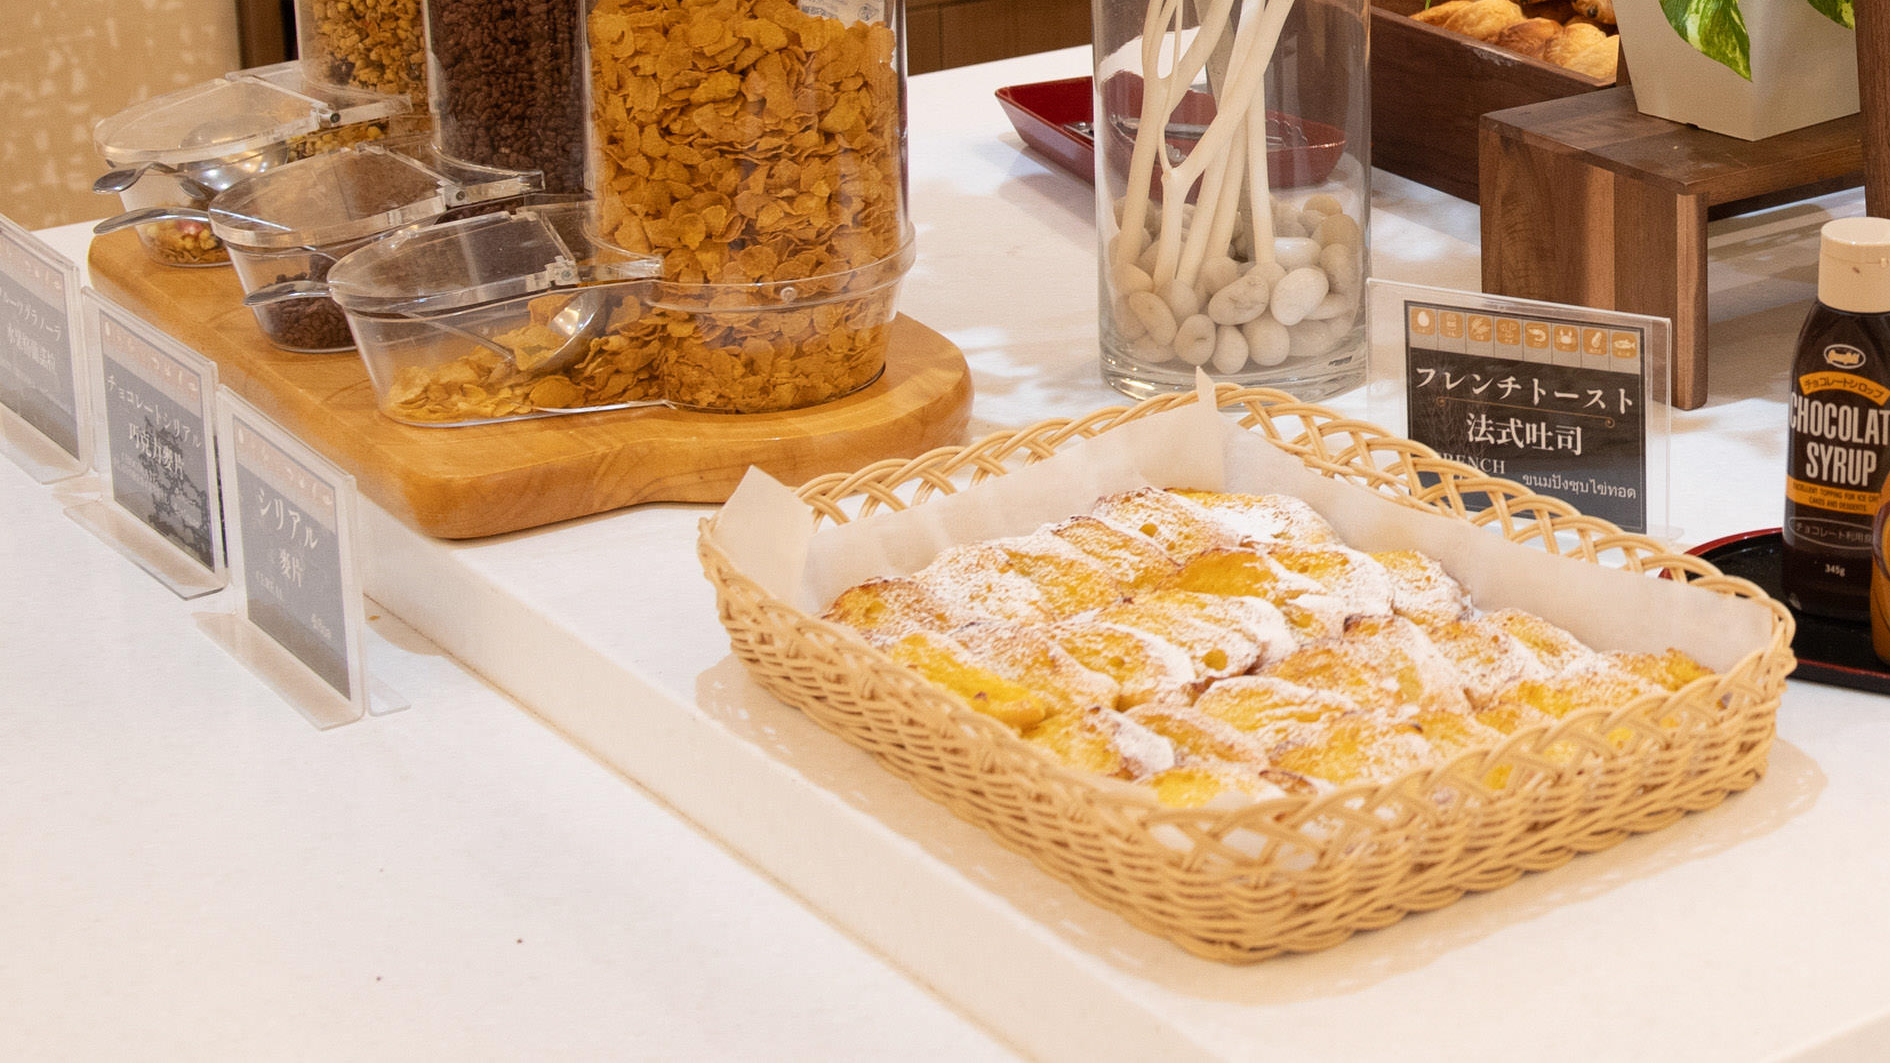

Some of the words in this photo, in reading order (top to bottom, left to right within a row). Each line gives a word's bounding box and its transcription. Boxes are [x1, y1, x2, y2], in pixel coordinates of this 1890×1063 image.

[0, 286, 62, 342] ルーツグラノーラ
[107, 374, 202, 449] チョコレートシリアル
[1415, 367, 1633, 415] フレンチトースト
[1804, 377, 1885, 399] チョコレートシロップ
[1466, 412, 1582, 456] 法式吐司
[1805, 441, 1878, 487] SYRUP
[256, 488, 319, 550] シリアル
